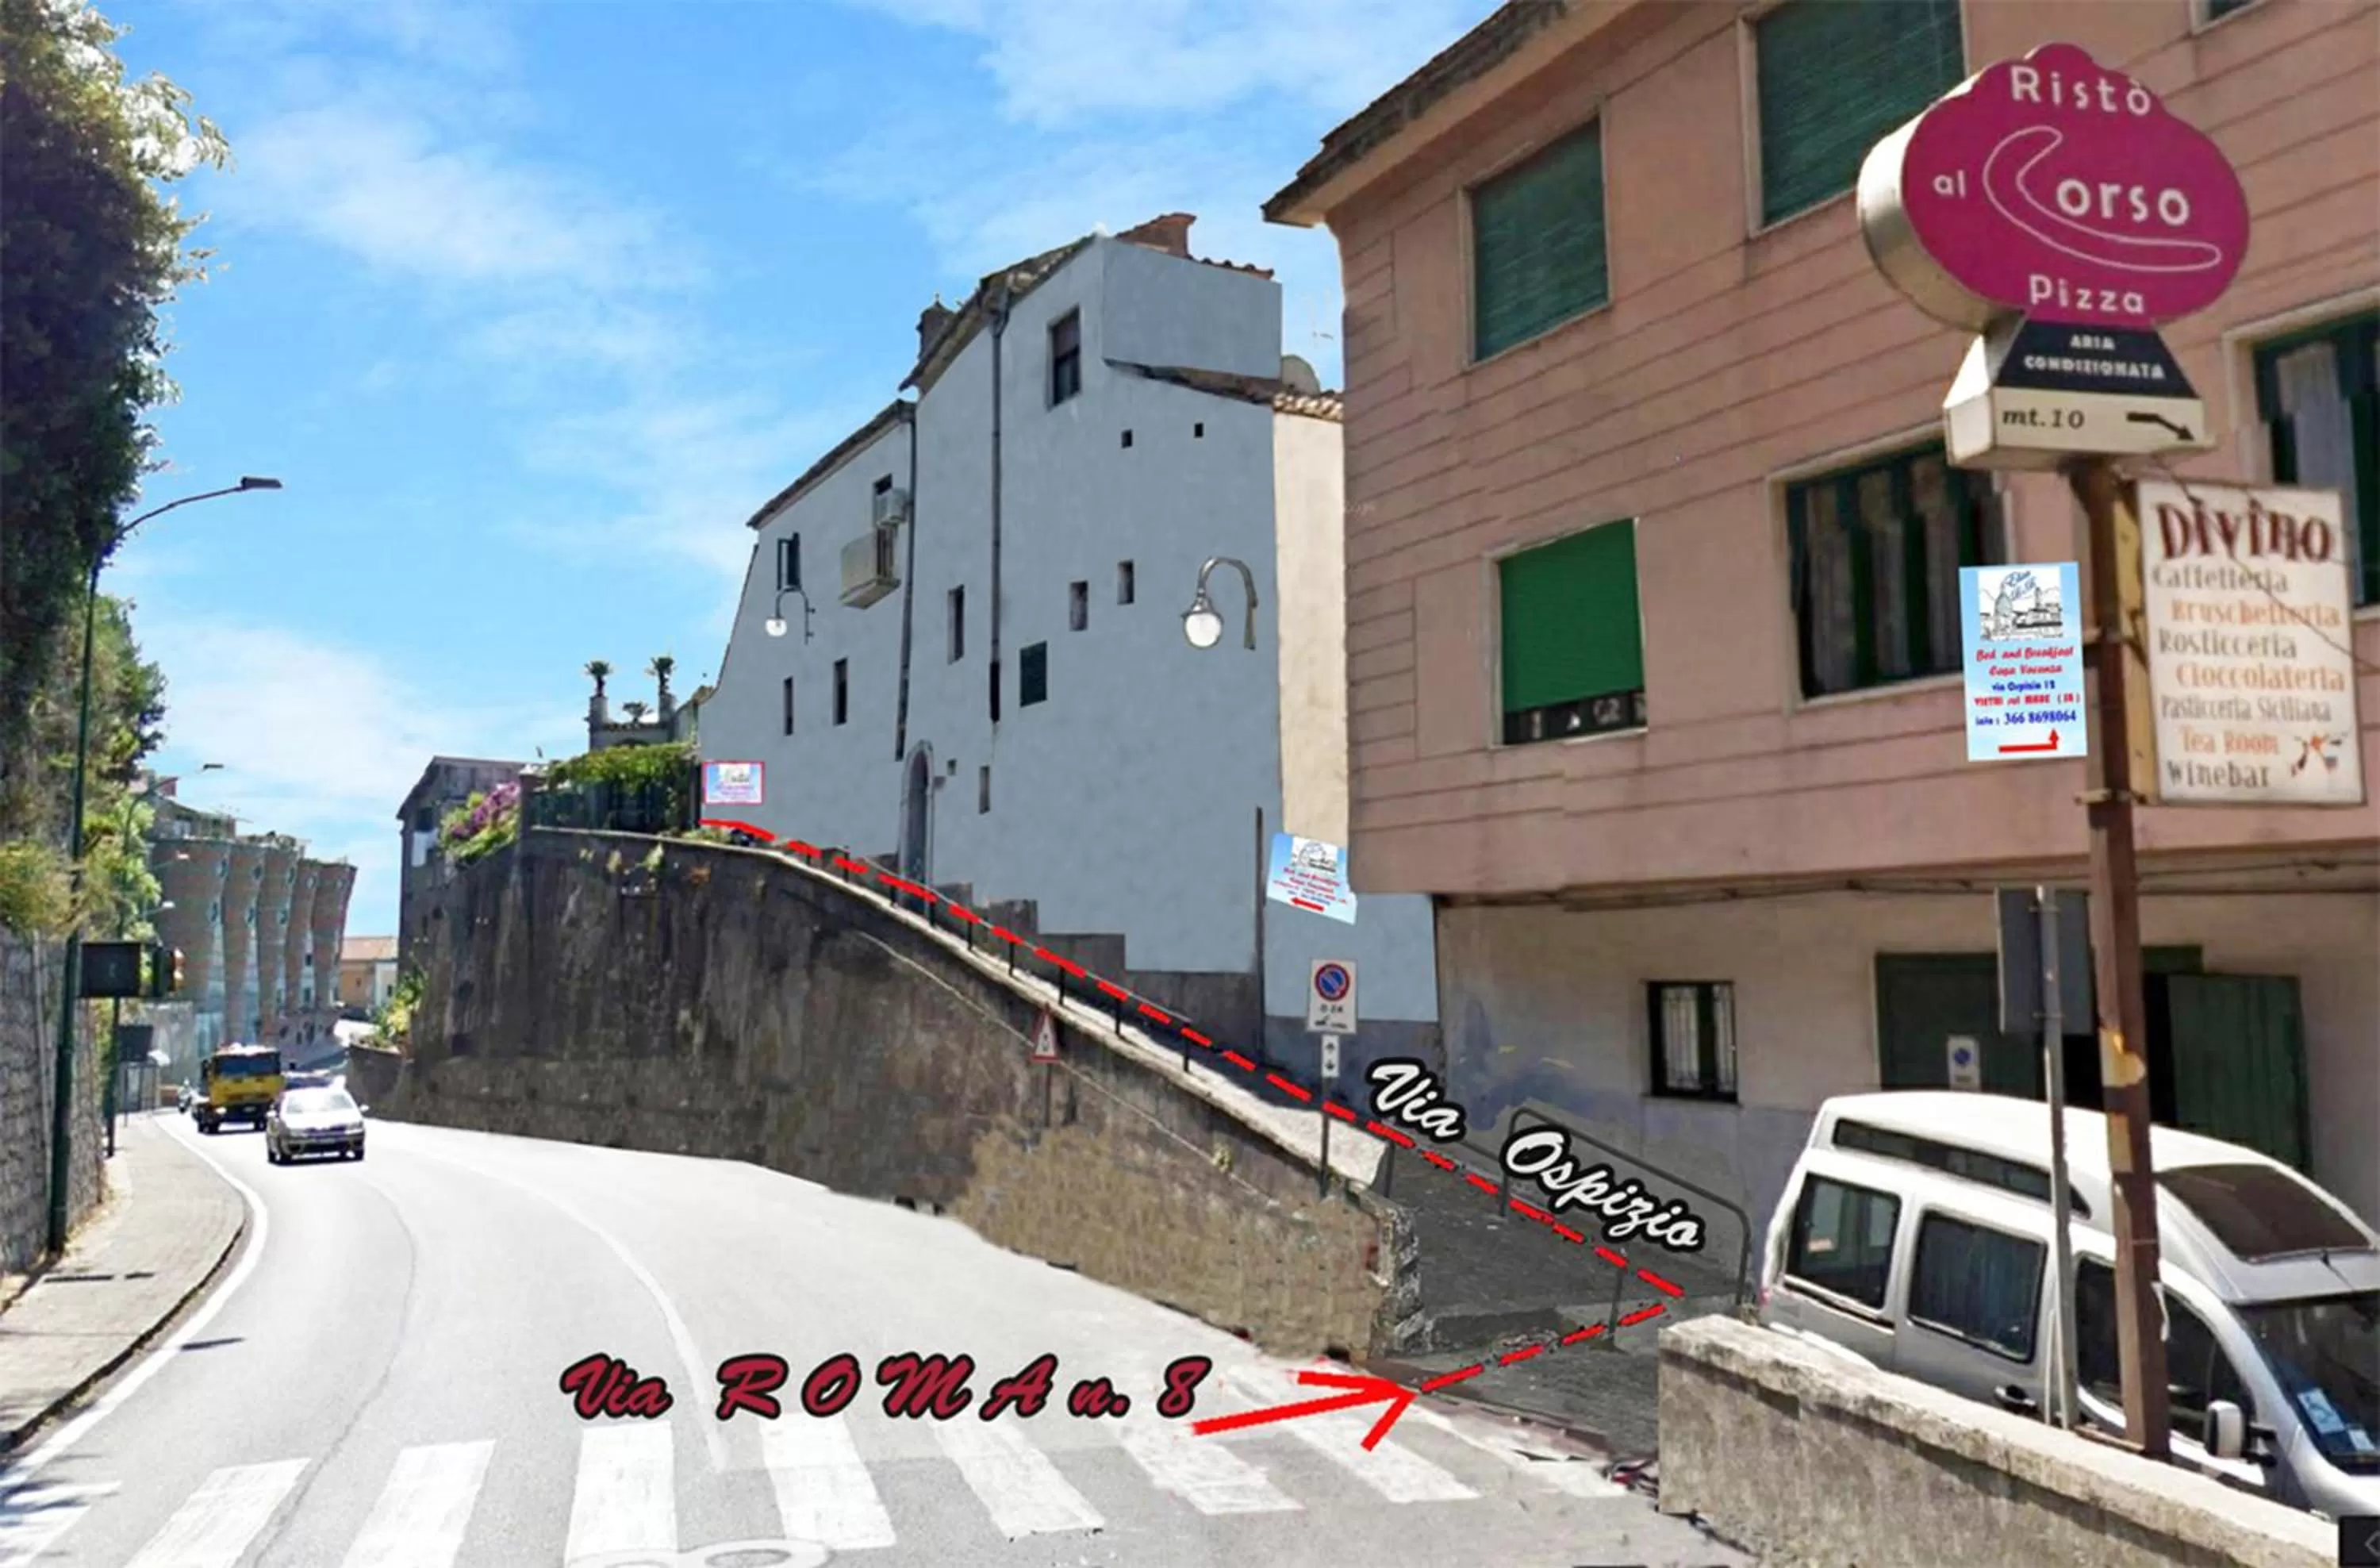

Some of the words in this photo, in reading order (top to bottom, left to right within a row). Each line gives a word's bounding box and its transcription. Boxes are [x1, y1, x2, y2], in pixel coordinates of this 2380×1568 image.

[2010, 66, 2152, 116] Ristò
[1933, 169, 1967, 198] al
[2028, 273, 2145, 315] Pizza
[2070, 334, 2116, 351] ARIA
[2024, 355, 2167, 379] CONDIZIONATA
[2159, 628, 2297, 658] Rosticceria
[2181, 725, 2216, 754] Tea
[2167, 759, 2271, 788] Winebar
